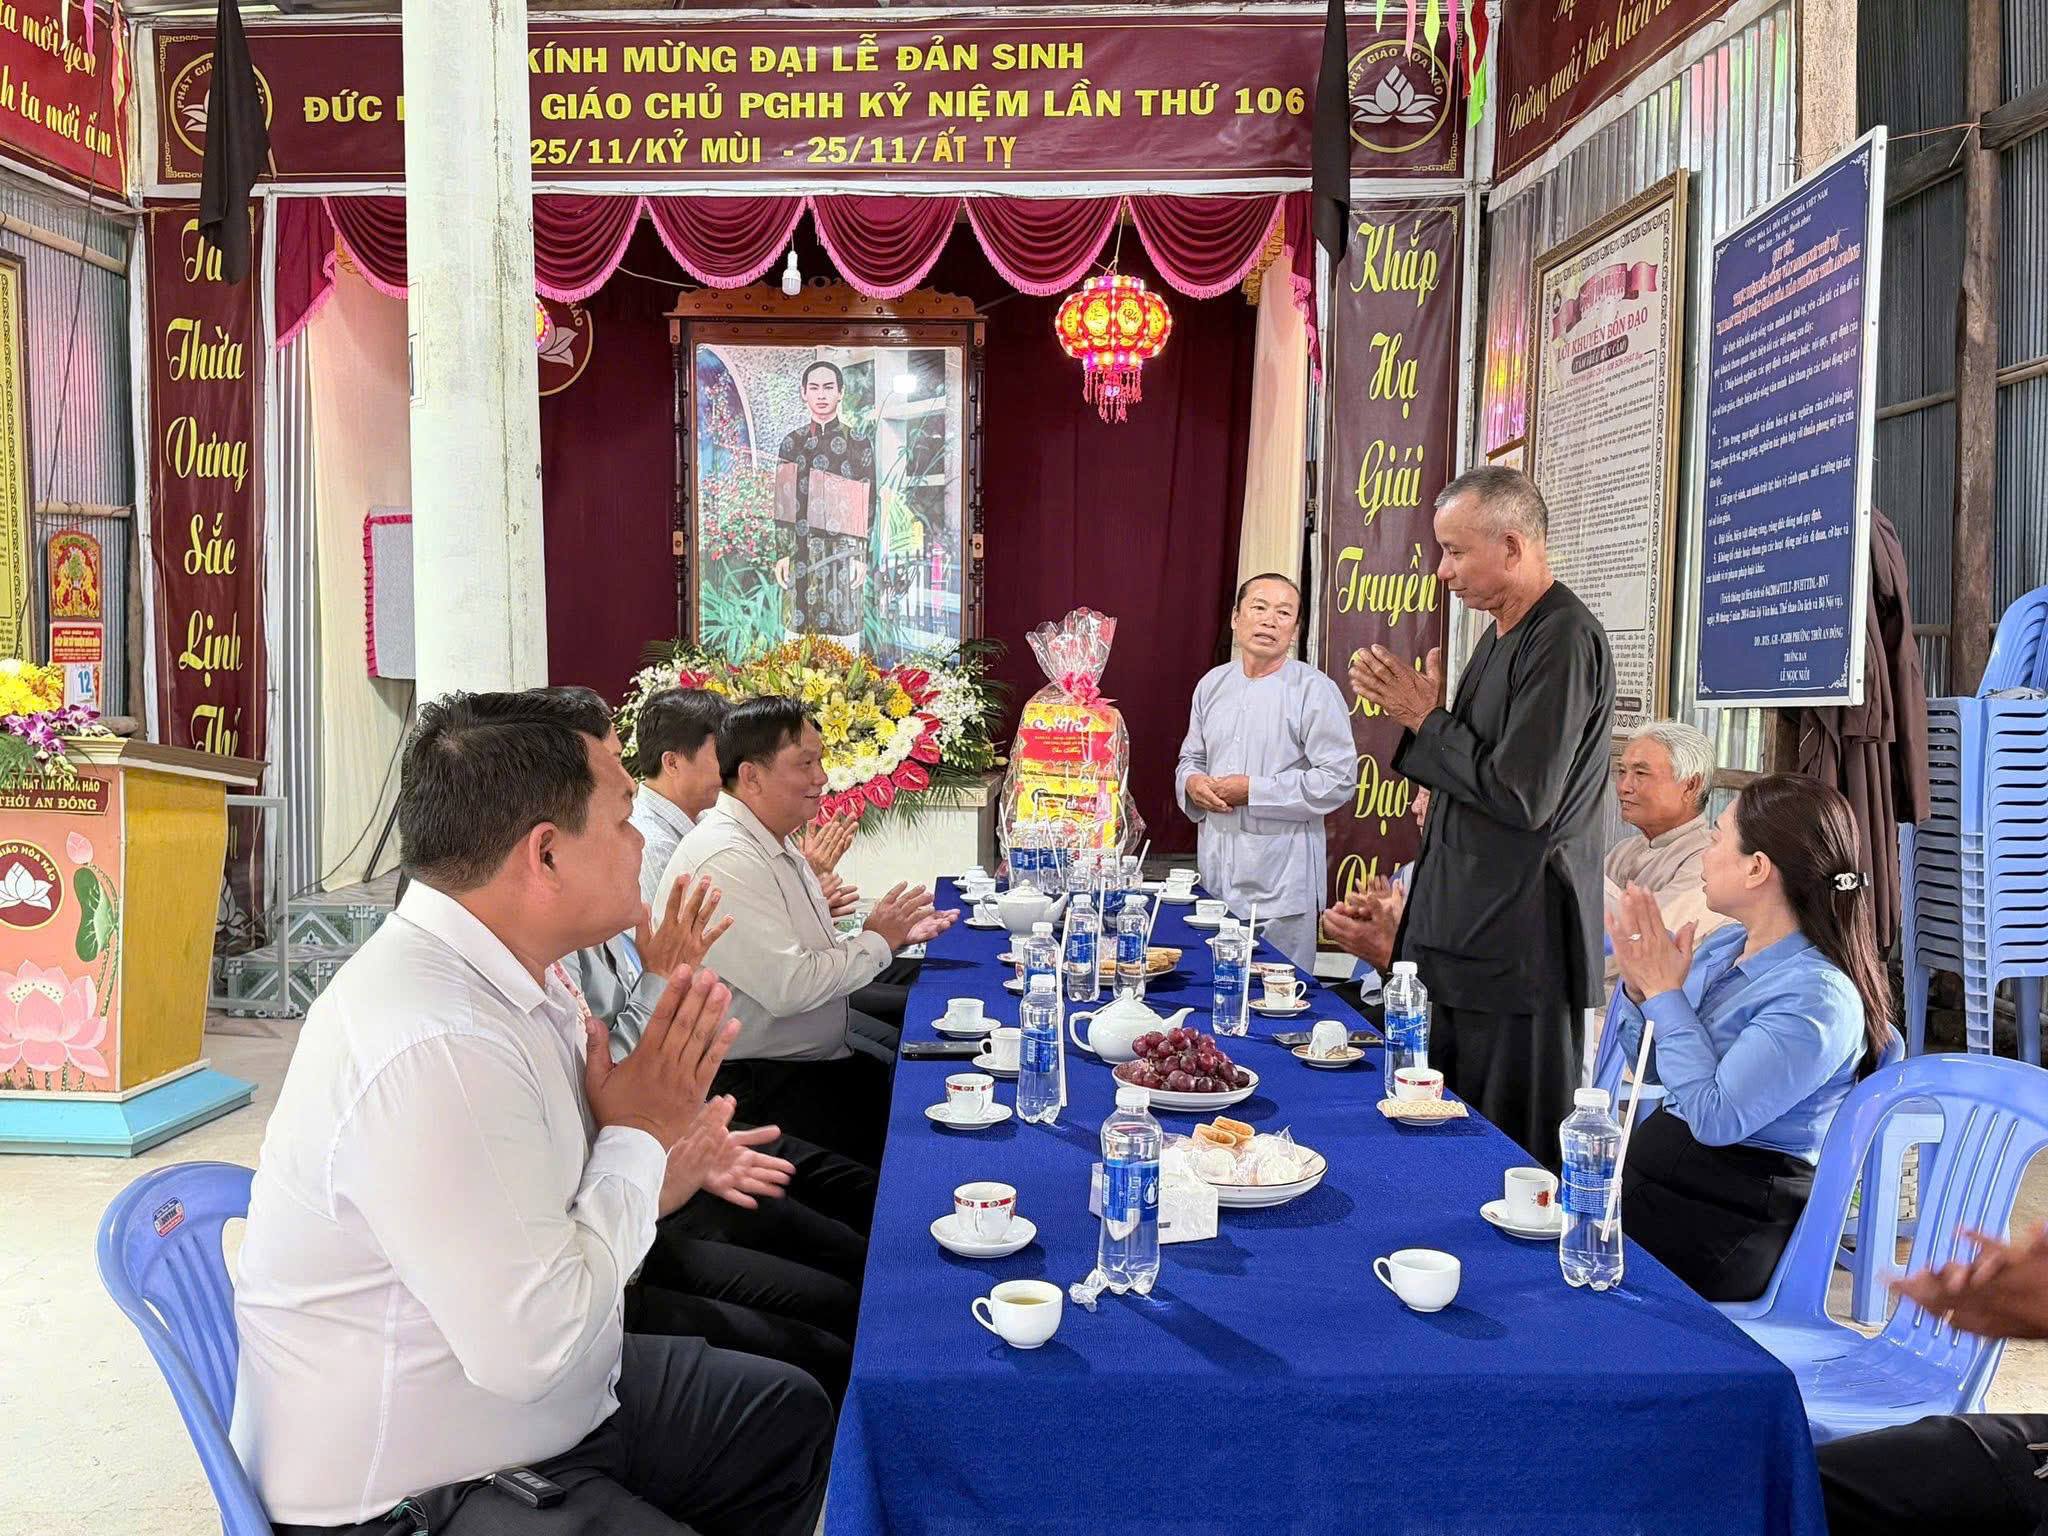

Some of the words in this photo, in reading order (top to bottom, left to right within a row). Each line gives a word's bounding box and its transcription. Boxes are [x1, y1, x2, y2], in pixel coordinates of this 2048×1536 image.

[23, 16, 60, 57] mới
[194, 59, 213, 77] GIÁ
[528, 42, 607, 74] KÍNH
[624, 40, 737, 74] MỪNG
[750, 46, 817, 78] ĐẠI
[832, 33, 879, 73] LỄ
[897, 35, 977, 72] ĐẢN
[992, 42, 1084, 71] SINH
[1366, 46, 1398, 65] GIÁO
[303, 89, 382, 122] ĐỨC
[540, 87, 633, 120] GIÁO
[644, 82, 723, 120] CHỦ
[740, 91, 844, 120] PGHH
[859, 82, 913, 119] KỶ
[928, 84, 1029, 123] NIỆM
[1043, 78, 1121, 118] LẦN
[1135, 82, 1221, 117] THỨ
[1234, 87, 1306, 115] 106
[1550, 38, 1582, 104] nuôi
[20, 82, 42, 125] ta
[46, 103, 81, 144] mới
[85, 110, 113, 159] ấm
[530, 127, 689, 165] 25/11/KỶ
[702, 131, 761, 164] MÙI
[806, 126, 967, 165] 25/11/ẤT
[1350, 219, 1439, 308] Khắp
[165, 317, 245, 381] Thừa
[1627, 306, 1649, 333] ĐẠO
[1369, 332, 1419, 420] Hạ
[165, 416, 248, 493] Vưng
[1355, 439, 1424, 527] Giái
[183, 512, 237, 575] Sắc
[1336, 543, 1440, 628] Truyền
[178, 609, 243, 688] Lịnh
[78, 670, 92, 694] 12
[34, 797, 55, 809] AN
[57, 796, 98, 810] ĐÔNG
[1355, 754, 1413, 837] Đạo
